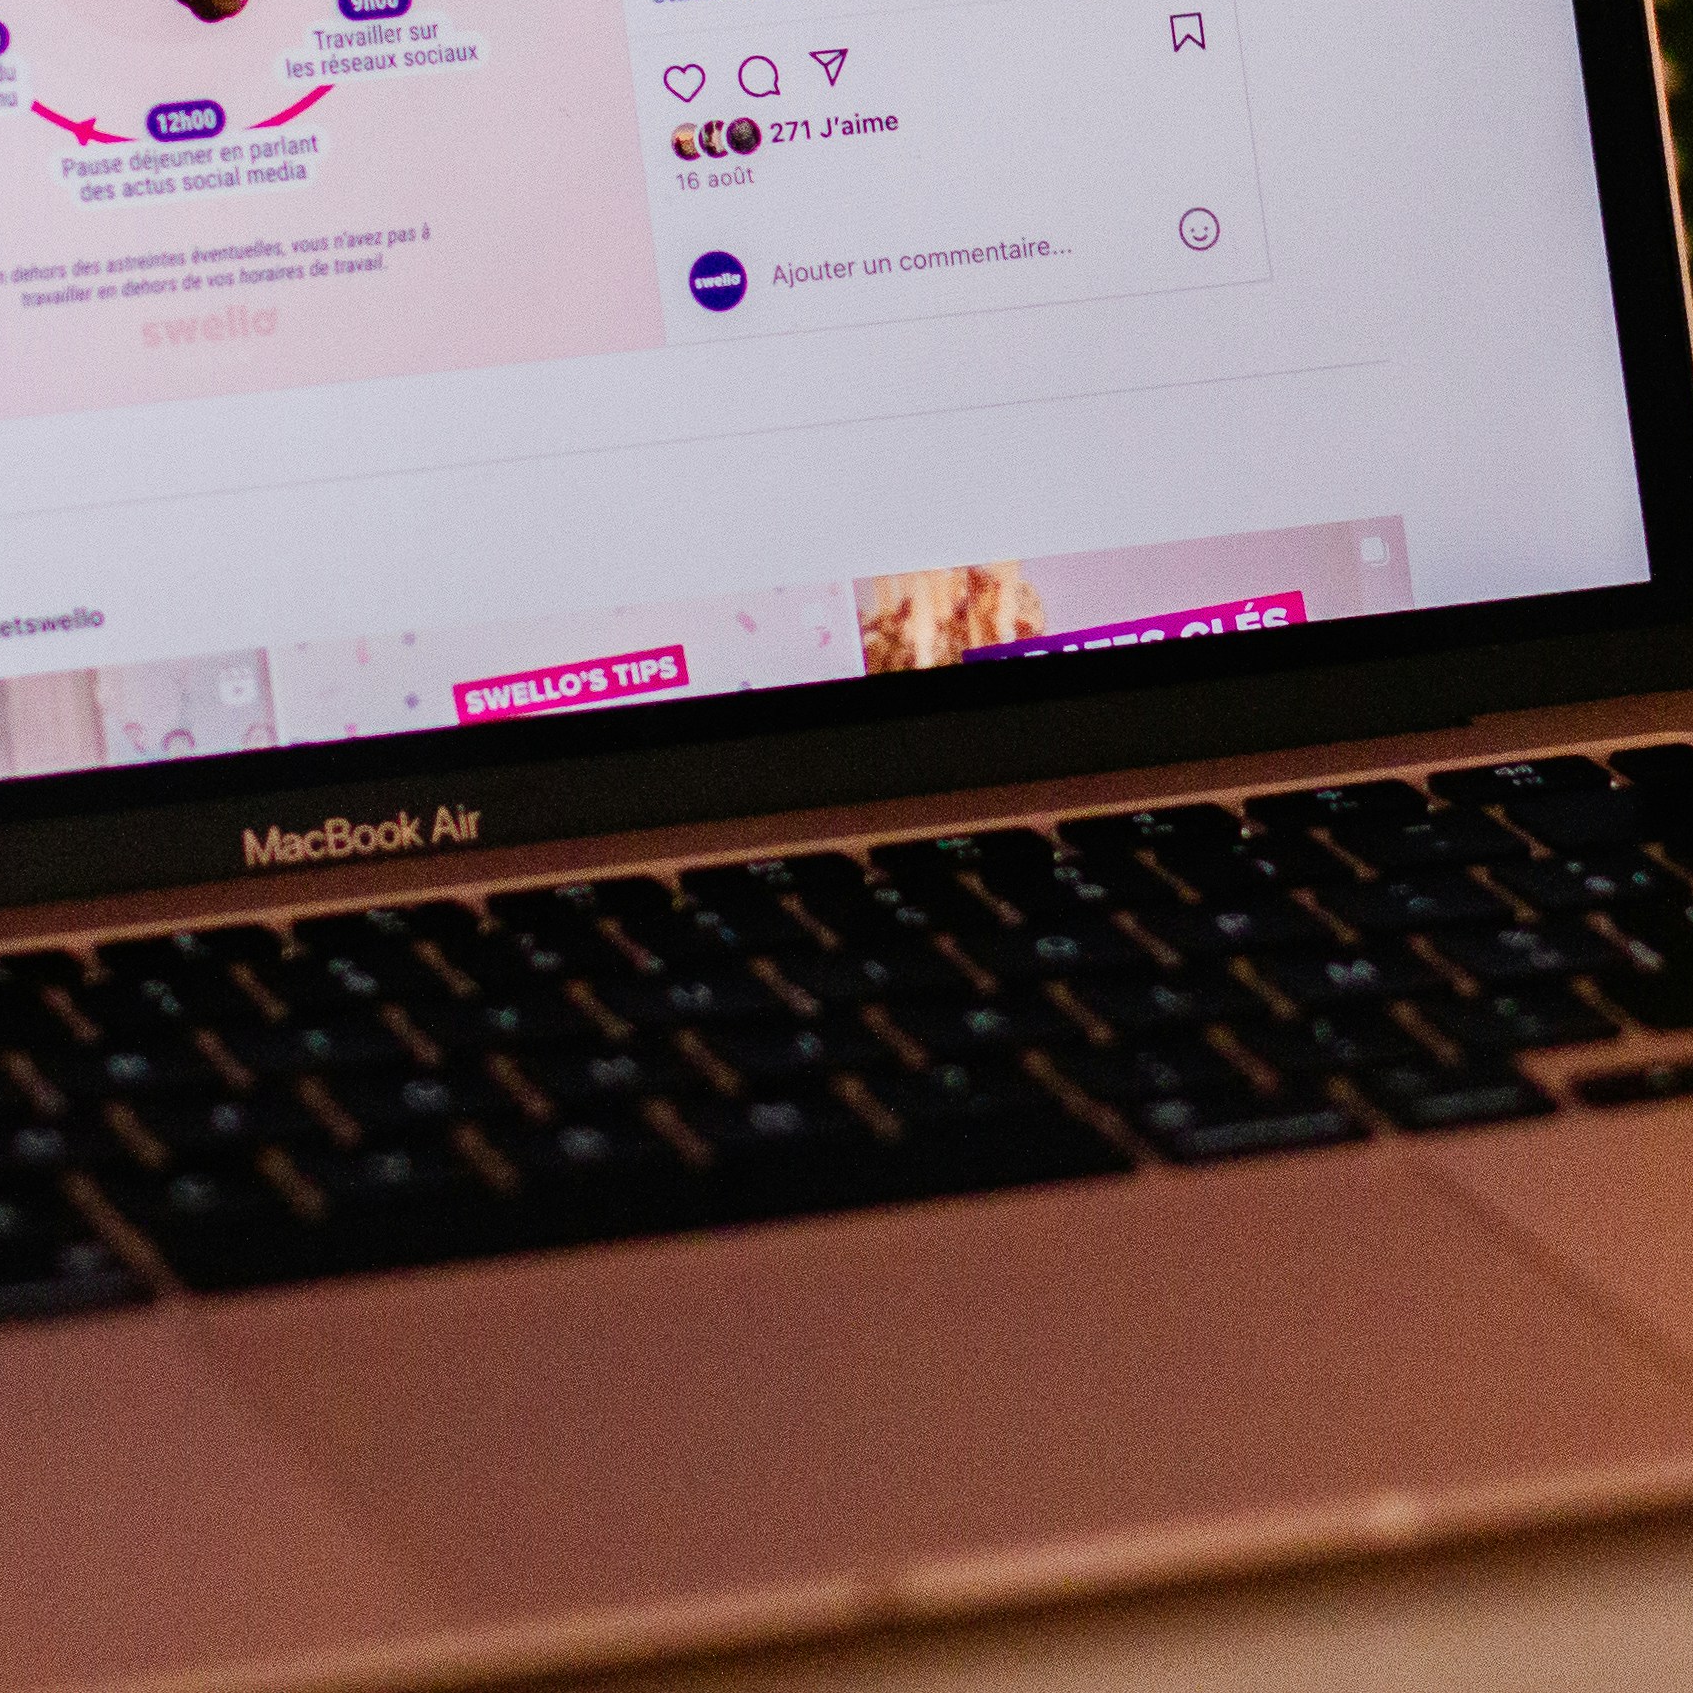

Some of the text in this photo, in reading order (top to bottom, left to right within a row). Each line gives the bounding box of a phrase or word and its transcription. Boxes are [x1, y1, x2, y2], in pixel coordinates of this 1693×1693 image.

[312, 22, 439, 51] Travailler sur
[284, 45, 479, 80] les réseaux sociaux
[155, 107, 218, 134] 12h00
[768, 118, 813, 145] 271
[60, 133, 320, 178] Pause déjeuner en parlant
[80, 162, 308, 204] des actus social media
[675, 164, 756, 192] 16 août
[771, 259, 856, 290] Ajouter
[862, 256, 894, 277] un
[464, 654, 679, 716] SWELLO'S TIPS
[243, 804, 483, 870] MacBook Air
